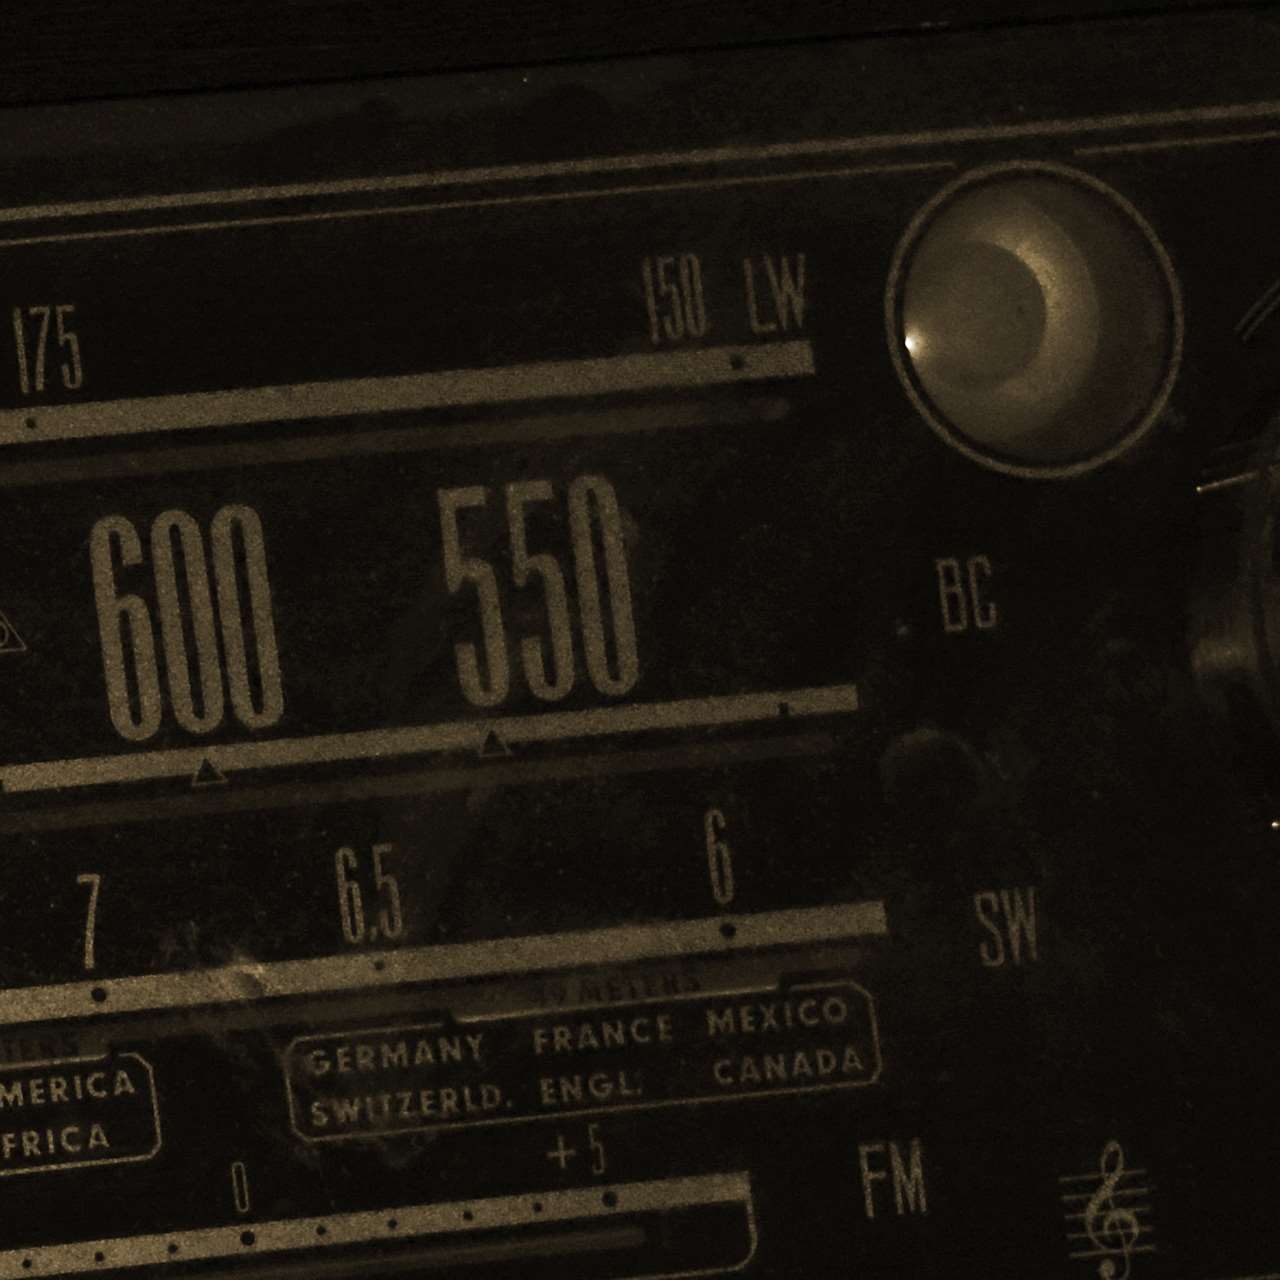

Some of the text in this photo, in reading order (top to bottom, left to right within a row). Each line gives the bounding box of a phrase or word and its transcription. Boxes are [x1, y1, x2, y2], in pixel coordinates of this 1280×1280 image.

[643, 253, 805, 343] 150 LW
[13, 305, 83, 394] 175
[90, 505, 284, 741] 600
[438, 475, 639, 707] 550
[936, 556, 997, 632] BC
[336, 844, 407, 943] 6,5
[705, 809, 734, 904] 6
[77, 874, 100, 969] 7
[974, 888, 1037, 967] SW
[308, 997, 847, 1075] GERMANY FRANCE MEXICO
[311, 1046, 864, 1127] SWITZERLD. ENGL. CANADA
[859, 1140, 926, 1218] FM
